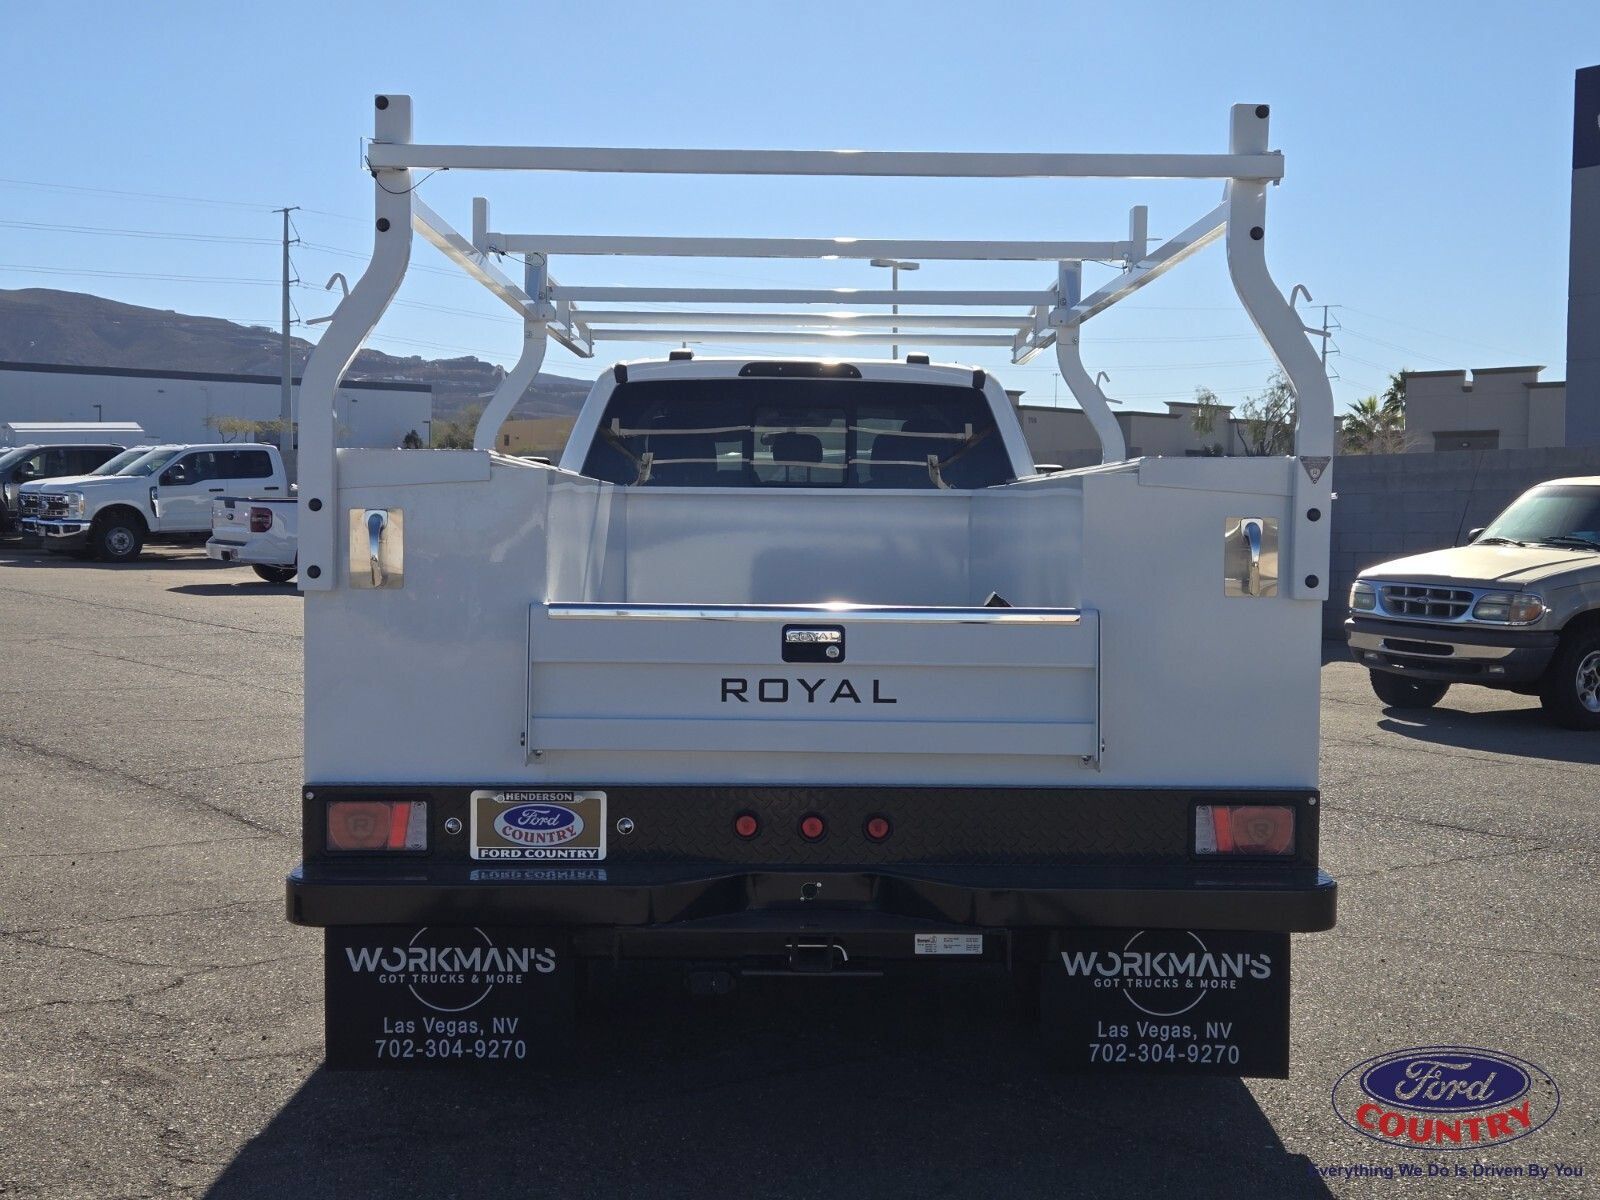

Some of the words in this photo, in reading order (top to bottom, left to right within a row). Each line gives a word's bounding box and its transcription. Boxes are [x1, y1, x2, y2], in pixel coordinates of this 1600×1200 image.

[788, 632, 840, 641] ROYAL
[721, 678, 898, 704] ROYAL
[505, 793, 573, 801] HENDERSON
[518, 809, 560, 826] Ford
[502, 825, 577, 843] COUNTRY
[480, 849, 522, 858] FORD
[524, 850, 597, 858] COUNTRY
[345, 947, 556, 973] WORKMAN'S
[1061, 951, 1271, 979] WORKMAN'S
[379, 974, 406, 984] GOT
[412, 974, 465, 984] TRUCKS
[471, 974, 479, 984] &
[486, 974, 523, 984] MORE
[1094, 978, 1120, 988] GOT
[1126, 979, 1179, 988] TRUCKS
[1185, 979, 1194, 988] &
[1200, 979, 1237, 989] MORE
[383, 1017, 416, 1034] Las
[422, 1017, 484, 1037] Vegas,
[492, 1017, 519, 1034] NV
[1098, 1021, 1129, 1038] Las
[1136, 1021, 1198, 1041] Vegas,
[1206, 1022, 1233, 1039] NV
[375, 1039, 526, 1059] 702-304-9270
[1089, 1043, 1240, 1064] 702-304-9270
